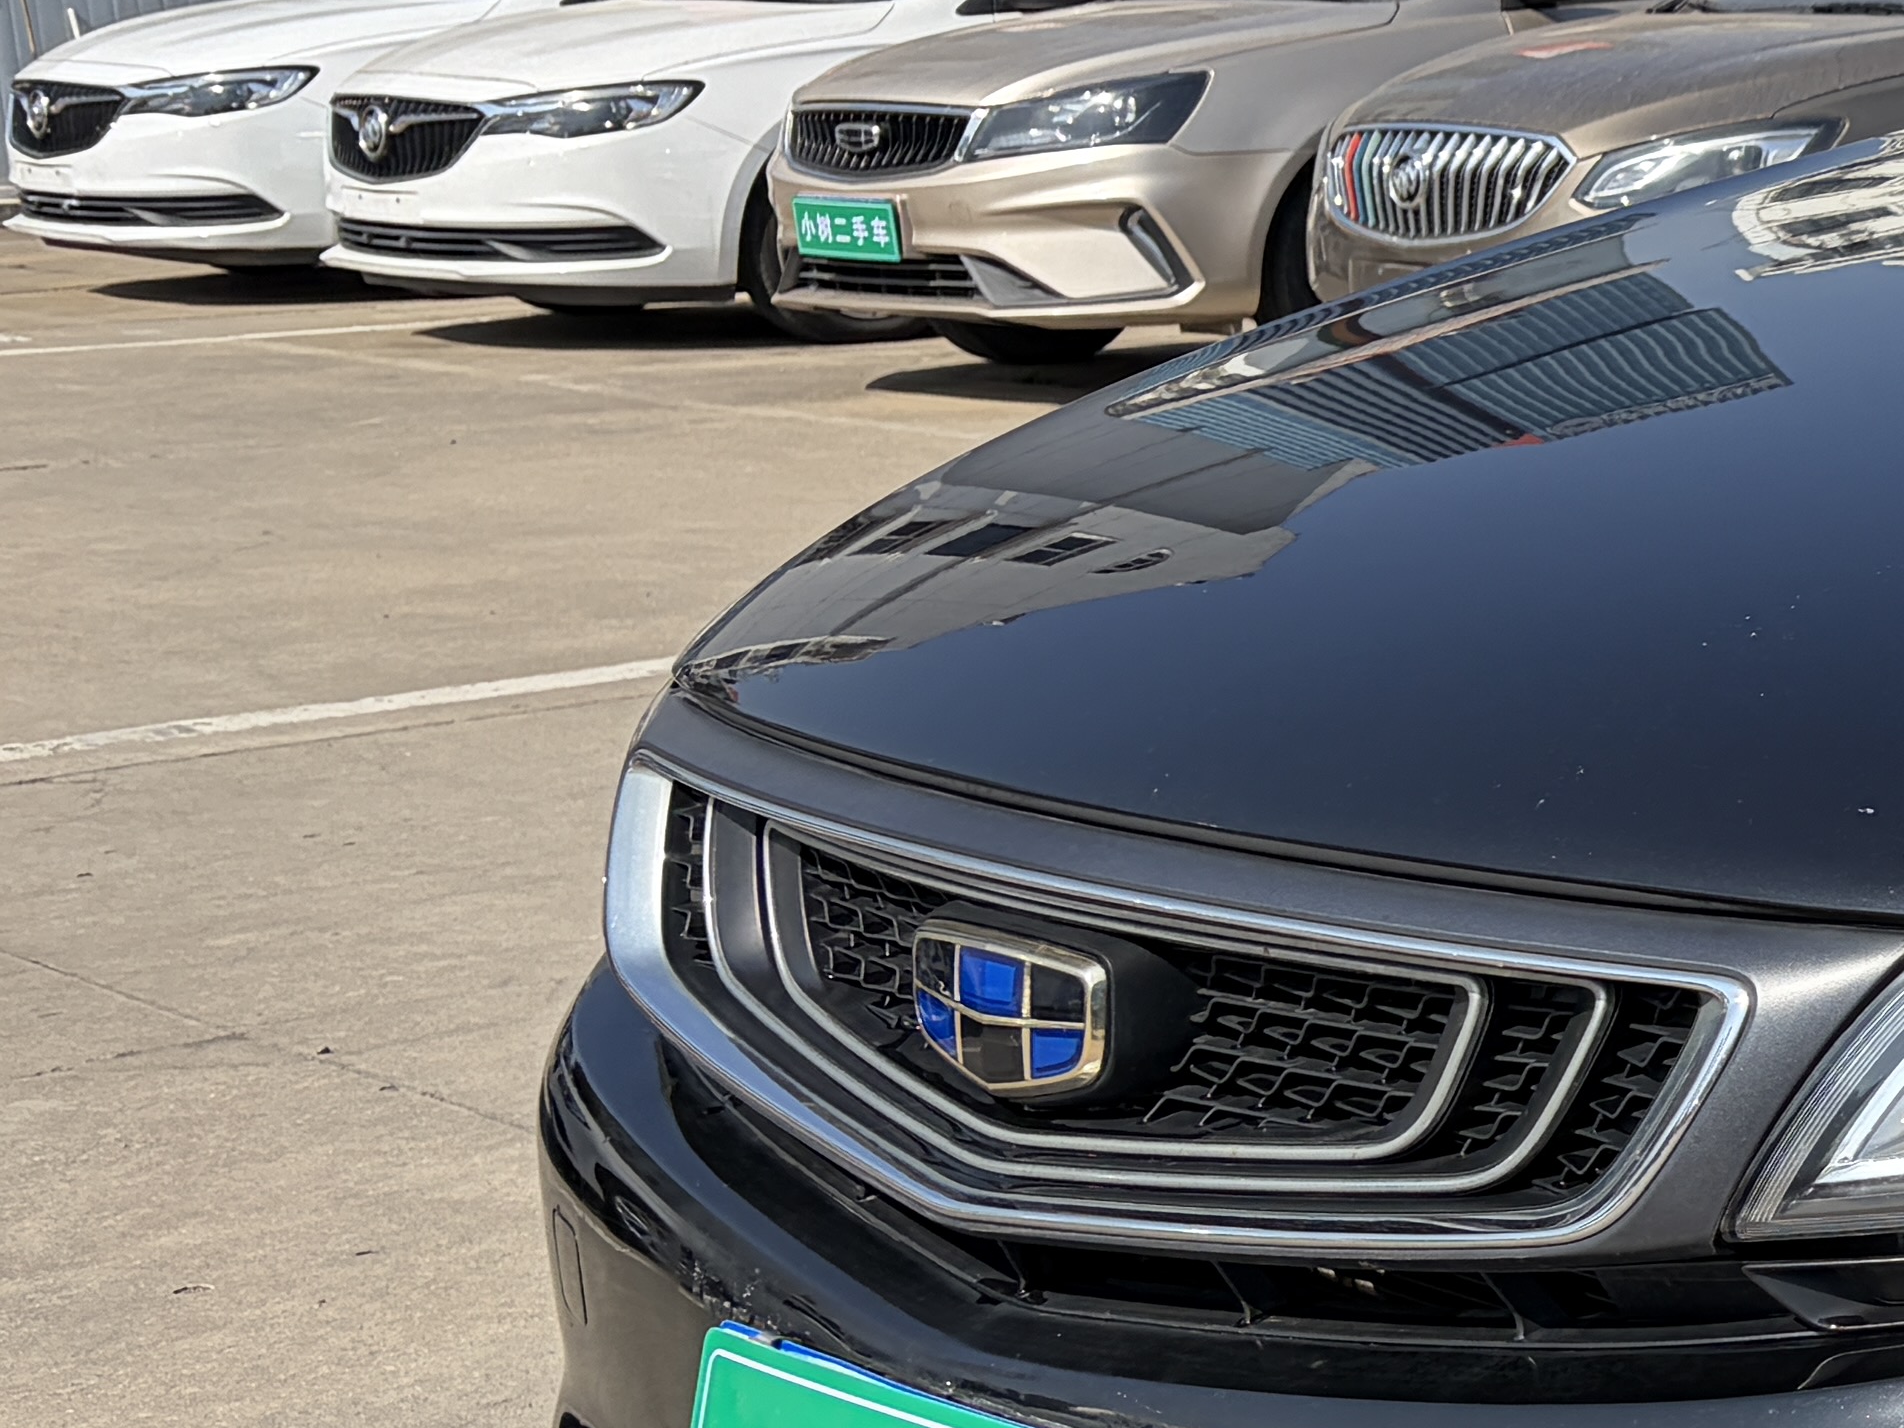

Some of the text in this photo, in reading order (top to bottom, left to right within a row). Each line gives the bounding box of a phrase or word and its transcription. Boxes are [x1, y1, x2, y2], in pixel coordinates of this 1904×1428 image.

[801, 210, 891, 249] 小树二手车
